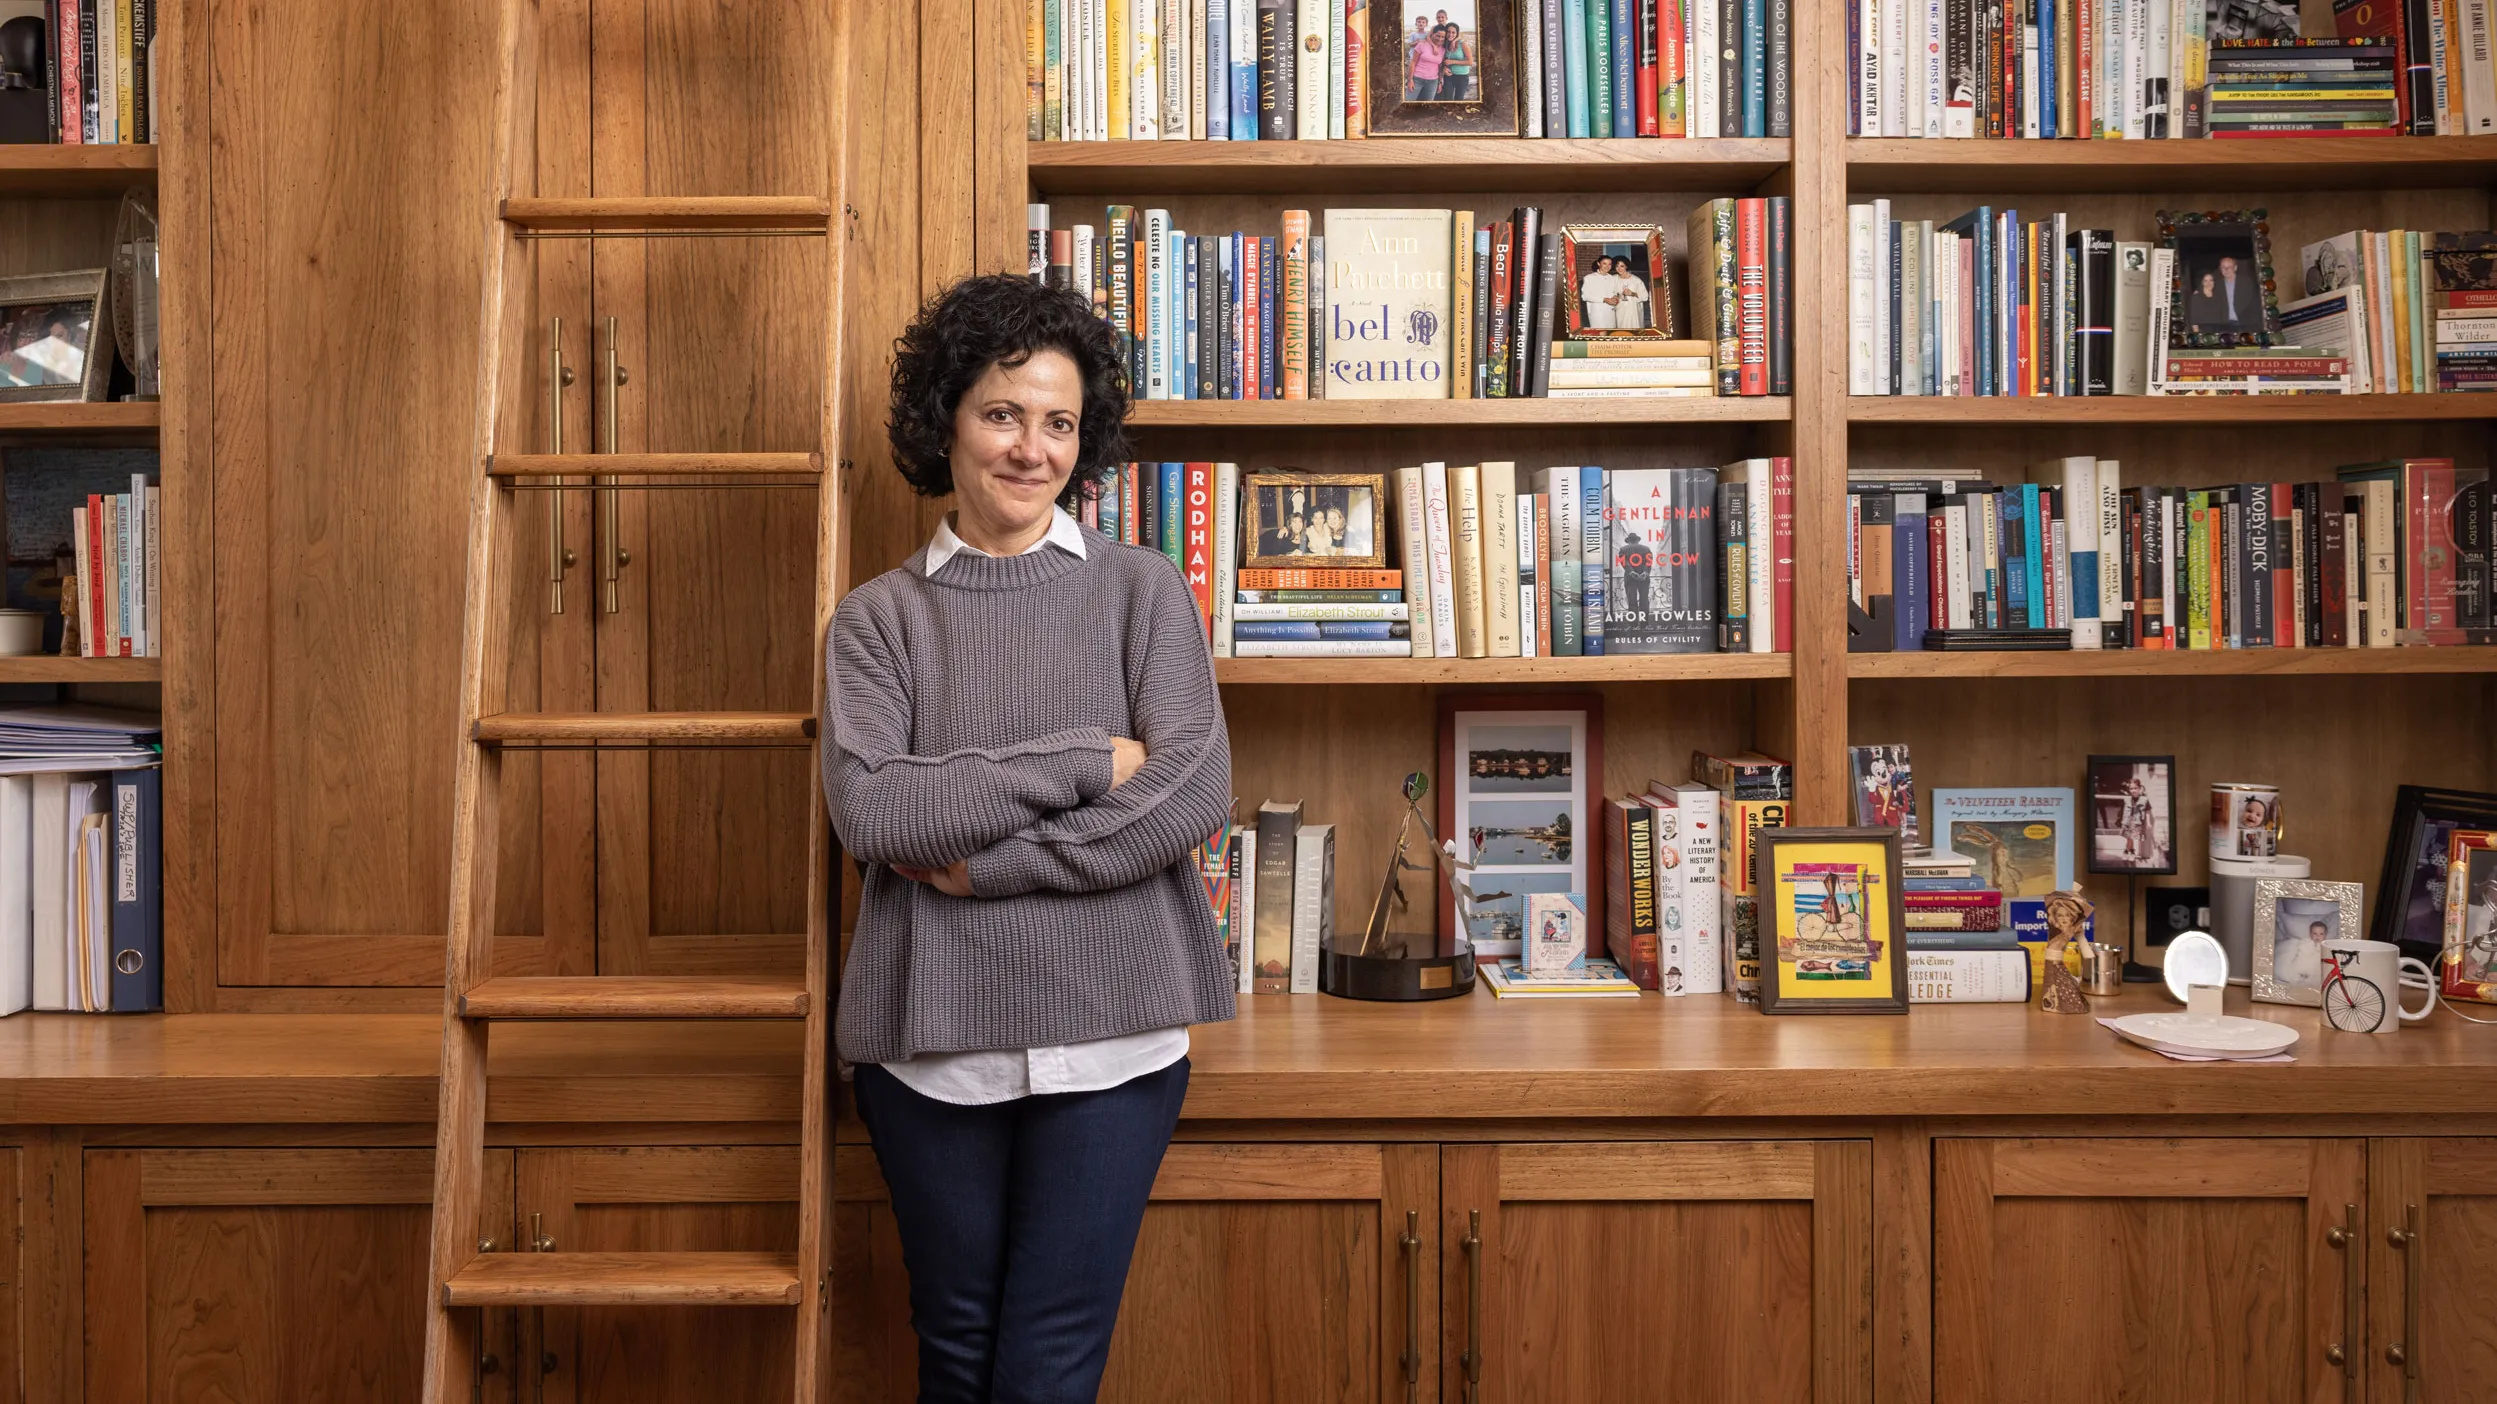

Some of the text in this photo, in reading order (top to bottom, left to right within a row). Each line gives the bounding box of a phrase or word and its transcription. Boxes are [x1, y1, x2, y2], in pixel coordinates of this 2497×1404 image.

[1082, 2, 1090, 41] FOSTER
[1212, 34, 1220, 48] JEAN
[2281, 38, 2294, 48] the
[2470, 3, 2487, 61] BY ANNIE DILLARD
[101, 35, 110, 109] BIRDS OF AMERICA
[1047, 2, 1055, 93] NEWS WORLD
[1262, 12, 1275, 110] WALLY LAMB
[1549, 22, 1559, 115] EVENING SHADES
[1598, 19, 1609, 114] PARIS BOOKSELLER
[1619, 33, 1629, 110] Alice McDermott
[1668, 37, 1678, 108] James McBride
[1775, 23, 1786, 105] OF THE WOODS
[1866, 52, 1877, 80] AYAD
[1991, 40, 2000, 103] DRINKING LIFE
[136, 65, 144, 109] DONALD RAY
[1169, 48, 1177, 107] DEMON COPPERHEAD
[1930, 57, 1939, 107] ROSS GAY
[2434, 39, 2448, 109] White Album
[119, 90, 128, 116] Inches
[1866, 82, 1877, 117] AKHTAR
[1112, 218, 1127, 259] HELLO
[1247, 243, 1256, 269] MAGGIE
[1359, 225, 1420, 254] Ann
[1151, 218, 1161, 373] CELESTE NG OUR MISSING HEARTS
[1263, 243, 1271, 334] HAMNET MAGGIE
[1332, 259, 1447, 291] Patchett
[1492, 243, 1509, 353] Bear Julia Phillips
[1907, 230, 1915, 365] BILLY COLLINS AIMLESS LOVE
[2040, 229, 2052, 320] Beautiful pointless
[1221, 283, 1231, 333] Tim O'Brien
[1331, 303, 1390, 341] bel
[1479, 289, 1487, 316] HORSES
[1722, 303, 1734, 336] Giants
[1742, 264, 1764, 364] THE VOLUNTEER
[2445, 321, 2497, 330] Thornton
[1286, 311, 1304, 376] HIMSELF
[1516, 301, 1528, 360] PHILIP ROTH
[2454, 332, 2491, 341] Wilder
[1167, 471, 1179, 549] Gary Shteyngart
[1220, 478, 1228, 527] ELIZABETH
[1458, 487, 1477, 543] The Help
[1602, 506, 1711, 521] GENTLEMAN
[1651, 485, 1661, 499] A
[2103, 484, 2111, 536] ALSO RISES
[2110, 492, 2118, 529] THE SUN
[119, 506, 128, 562] MICHAEL CHABON
[148, 499, 156, 587] Stephen King On Writing
[1190, 470, 1207, 585] RODHAM
[1428, 498, 1450, 584] Queen Tuesday
[1495, 493, 1506, 550] DONNA TARTT
[1561, 476, 1572, 604] THE MAGICIAN COLM
[1647, 529, 1665, 542] IN
[1749, 501, 1758, 585] ANNE TYLER
[1759, 479, 1769, 607] DIGGING TO AMERICA
[2251, 486, 2267, 572] MOBY-DICK
[2468, 491, 2478, 547] LEO TOLSTOY
[1409, 501, 1425, 624] STRAUB THIS TIME TOMORROW
[1539, 508, 1548, 602] BROOKLYN COLM
[1586, 487, 1602, 633] COLM LONG ISLAND
[1615, 552, 1700, 567] MOSCOW
[1731, 548, 1742, 611] RULES CIVILITY
[1936, 560, 1944, 594] Expectations
[1243, 626, 1384, 636] Anything Is Possible Elizabeth Strout
[1287, 606, 1385, 618] Elizabeth Strout
[1604, 610, 1712, 623] AMOR TOWLES
[1615, 636, 1701, 644] RULES OF CIVILITY
[1748, 812, 1758, 823] of
[1957, 796, 2064, 807] VELVETEEN RABBIT
[1203, 862, 1225, 870] FEMALE
[1209, 854, 1220, 862] THE
[1244, 836, 1253, 865] Another
[1630, 818, 1653, 929] WONDERWORKS
[1687, 847, 1716, 855] LITERARY
[1698, 866, 1706, 874] OF
[1243, 866, 1252, 897] Brooklyn
[1661, 874, 1672, 884] By
[1662, 891, 1682, 900] Book
[1689, 876, 1716, 884] AMERICA
[1304, 852, 1320, 962] A LITTLE LIFE
[1908, 971, 1953, 981] ESSENTIAL
[1926, 956, 1955, 966] Times
